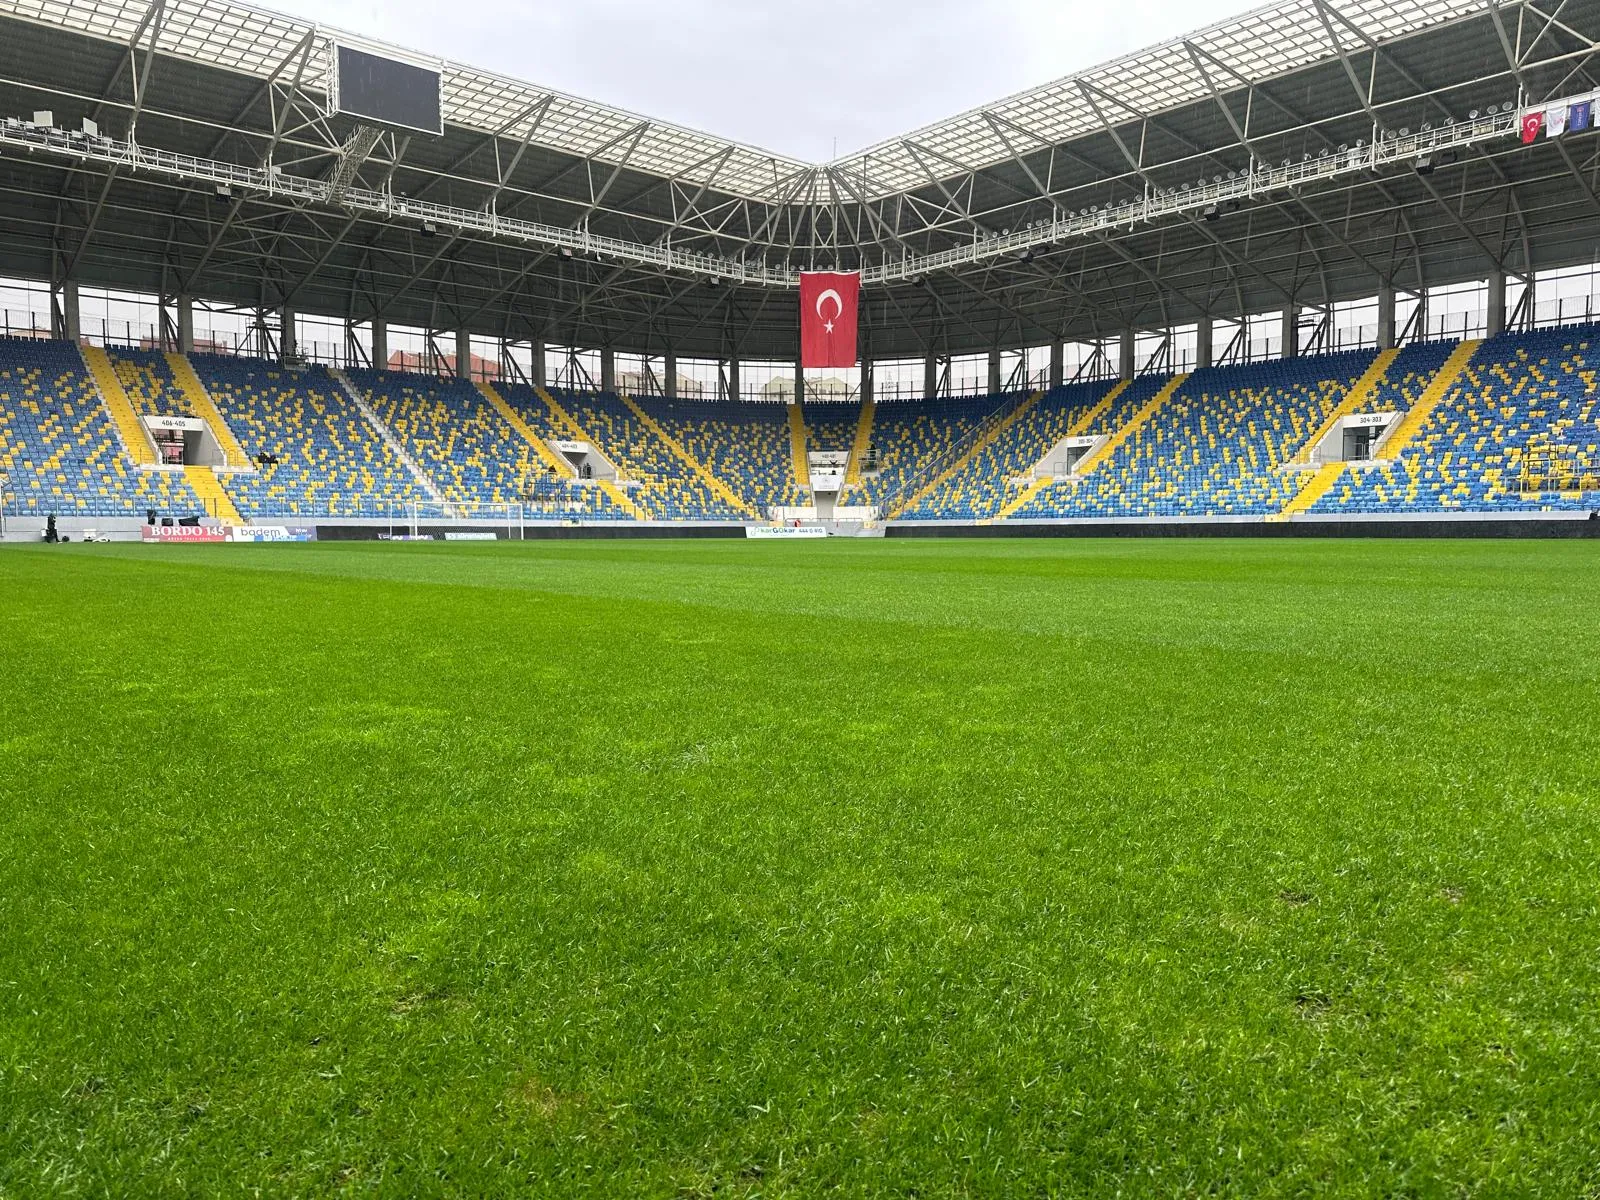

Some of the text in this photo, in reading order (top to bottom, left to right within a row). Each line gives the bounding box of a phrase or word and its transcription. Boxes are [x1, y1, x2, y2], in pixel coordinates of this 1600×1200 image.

[161, 419, 186, 427] 406-405
[151, 526, 225, 536] BORDO 145
[240, 528, 280, 537] badem
